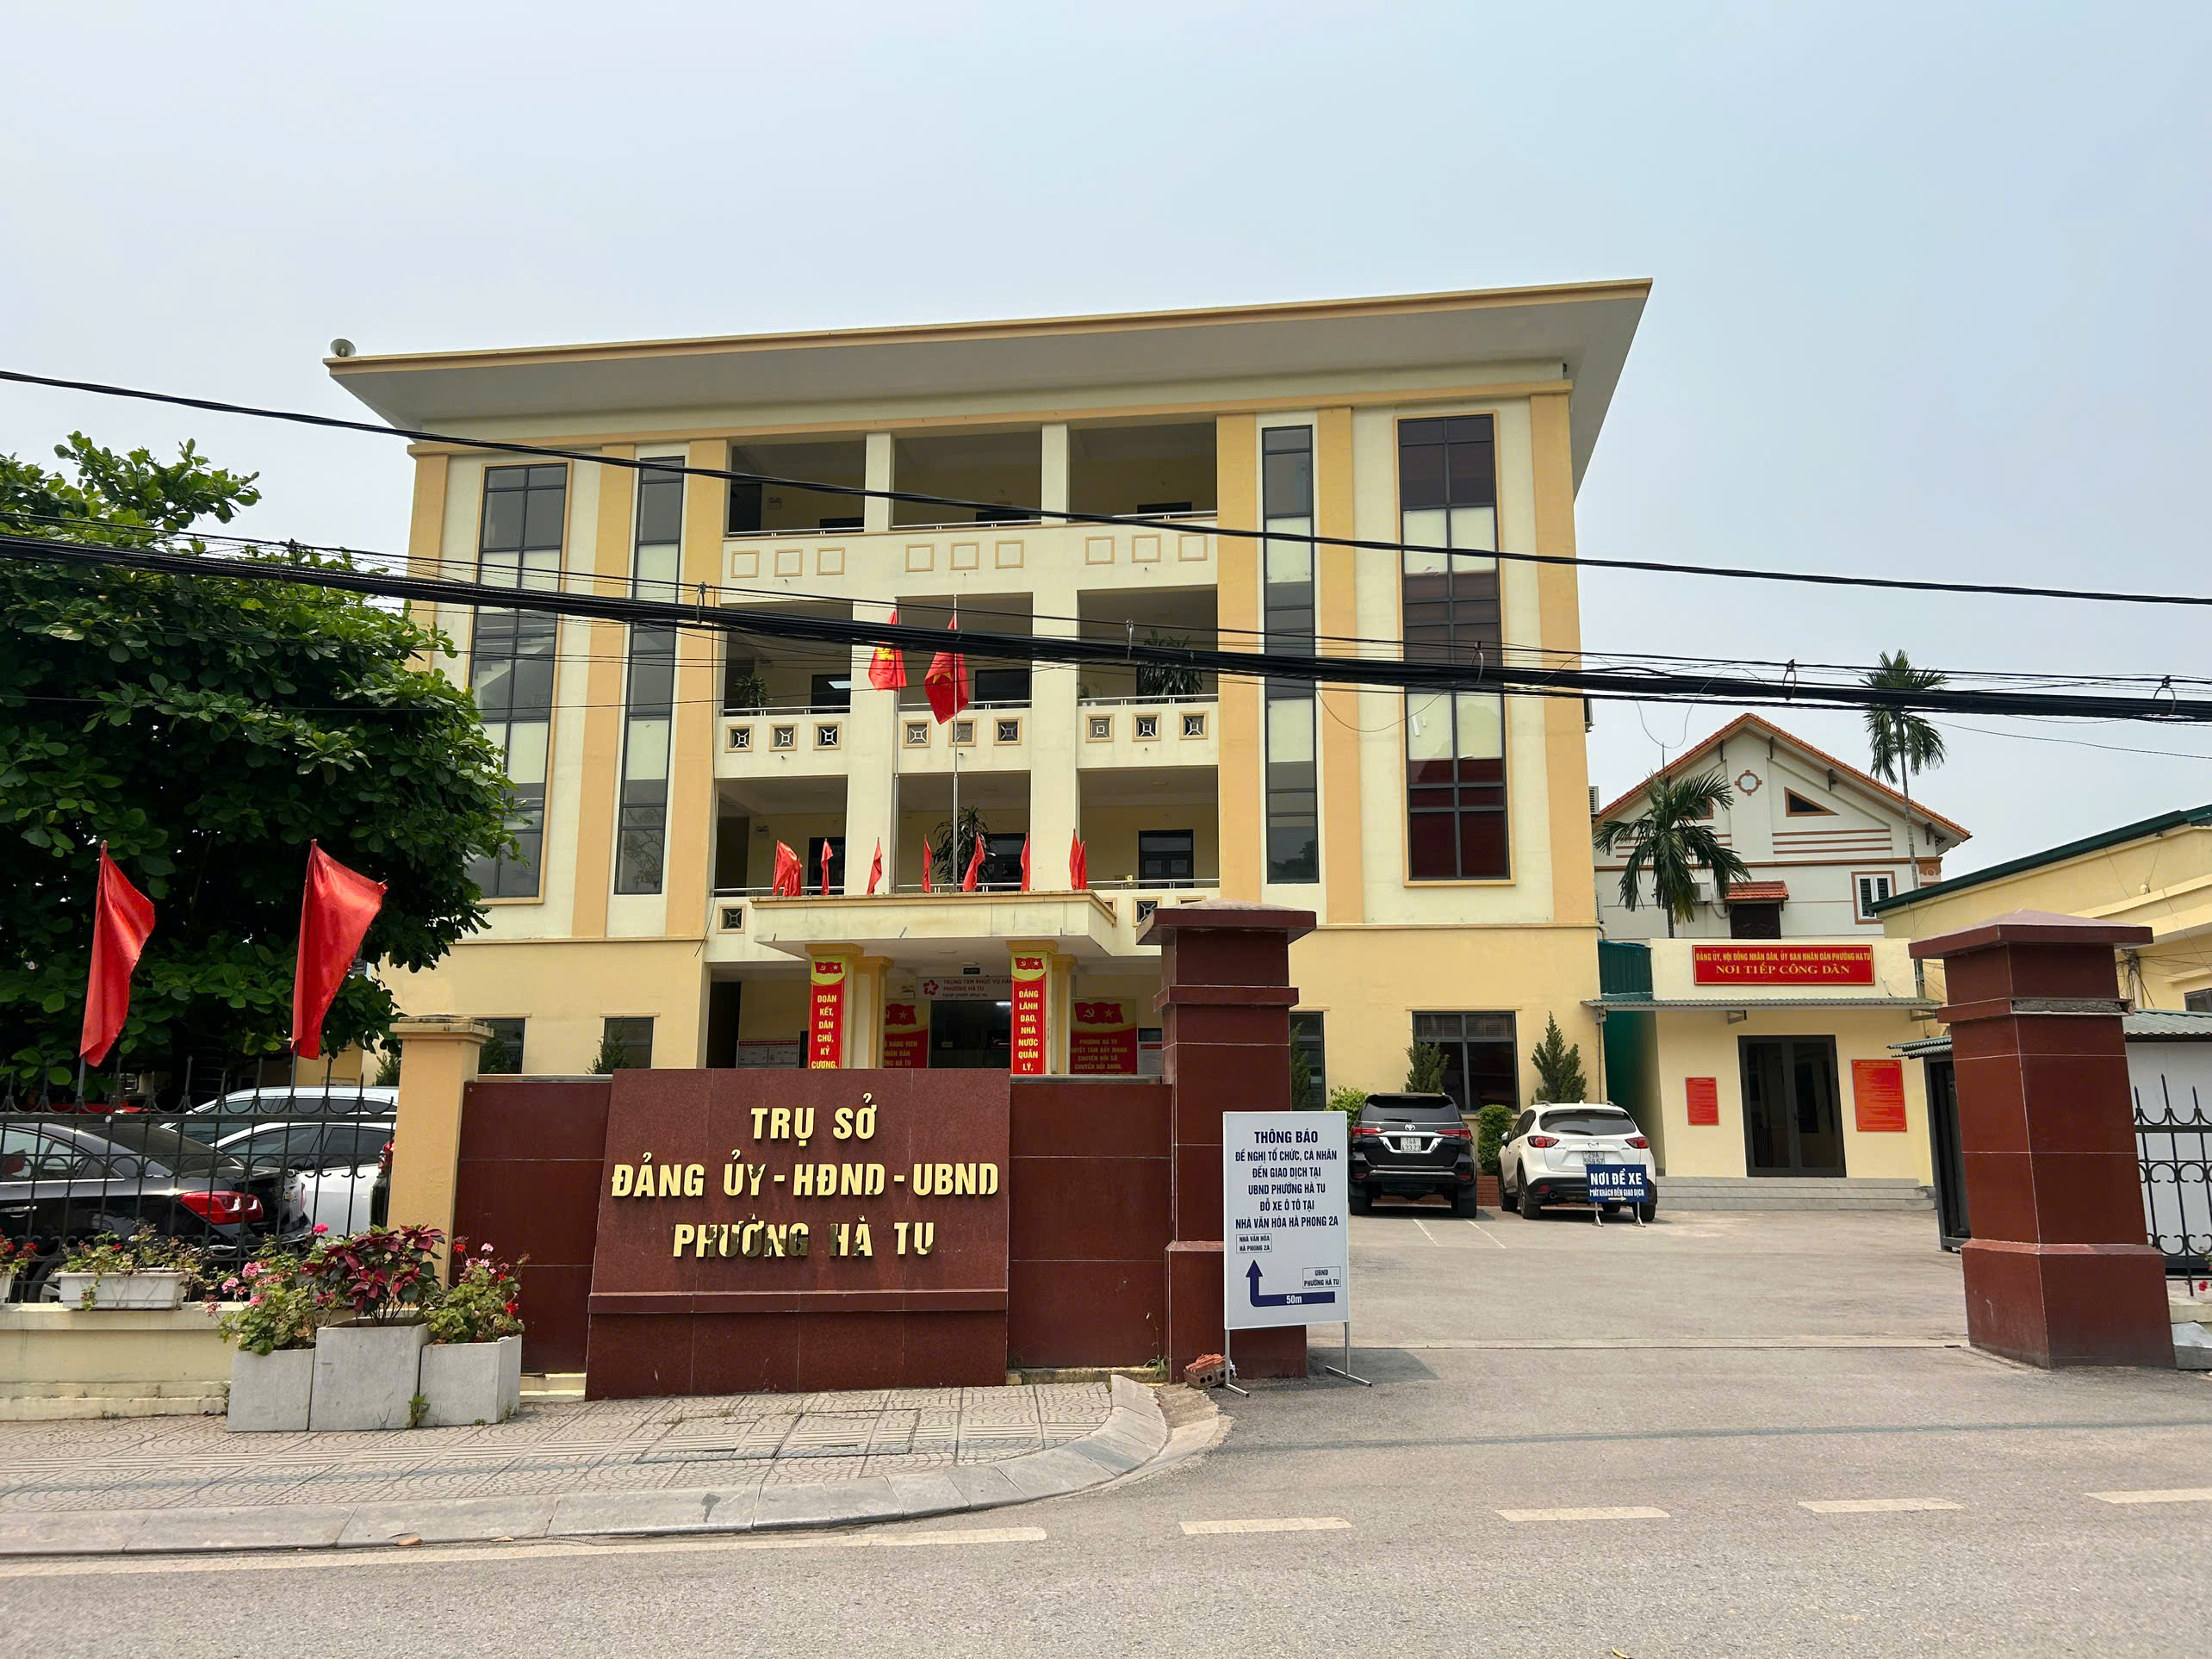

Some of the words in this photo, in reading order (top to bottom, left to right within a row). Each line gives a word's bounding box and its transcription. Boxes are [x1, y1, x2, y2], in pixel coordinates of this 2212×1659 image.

[1749, 951, 1765, 961] NHÂN
[1789, 952, 1801, 961] BAN
[1802, 951, 1818, 961] NHÂN
[1819, 951, 1831, 961] DÂN
[1715, 965, 1740, 974] NƠI
[1743, 961, 1776, 974] TIẾP
[1779, 963, 1817, 974] CÔNG
[1822, 963, 1850, 974] DÂN
[817, 993, 837, 1003] ĐOÀN
[1018, 989, 1039, 998] ĐẢNG
[1019, 1001, 1038, 1010] LÃNH
[818, 1019, 834, 1029] DÂN
[1021, 1025, 1036, 1035] NHÀ
[1018, 1037, 1039, 1047] NƯỚC
[1018, 1048, 1039, 1059] QUẢN
[750, 1107, 815, 1146] TRỤ
[832, 1092, 878, 1140] SỞ
[1254, 1128, 1292, 1144] THÔNG
[1296, 1128, 1319, 1144] BÁO
[1247, 1151, 1266, 1163] NGHỊ
[1268, 1146, 1277, 1161] TỔ
[1279, 1148, 1302, 1162] CHỨC,
[1316, 1148, 1338, 1160] NHÂN
[611, 1152, 705, 1197] ĐẢNG
[723, 1148, 767, 1196] ỦY
[792, 1163, 886, 1196] HĐND
[912, 1163, 999, 1196] UBND
[1252, 1165, 1268, 1178] ĐẾN
[1270, 1167, 1288, 1177] GIAO
[1289, 1167, 1308, 1179] DỊCH
[1309, 1166, 1321, 1179] TẠI
[1590, 1171, 1610, 1185] NƠI
[1611, 1167, 1626, 1185] ĐỂ
[1628, 1172, 1643, 1185] XE
[1248, 1184, 1269, 1196] UBND
[1271, 1181, 1302, 1195] PHƯỜNG
[1304, 1181, 1314, 1194] HÀ
[1316, 1183, 1326, 1193] TU
[1272, 1201, 1283, 1211] XE
[1284, 1198, 1289, 1211] Ô
[1291, 1198, 1301, 1211] TÔ
[1302, 1200, 1314, 1214] TẠI
[1235, 1216, 1252, 1229] NHÀ
[1253, 1216, 1270, 1228] VĂN
[1271, 1215, 1287, 1228] HÓA
[1289, 1215, 1300, 1227] HÀ
[1301, 1216, 1327, 1227] PHONG
[1328, 1215, 1339, 1227] 2A
[672, 1213, 810, 1258] PHƯỜNG
[829, 1215, 873, 1258] HÀ
[893, 1221, 935, 1256] TU
[1303, 1278, 1324, 1287] PHƯỜNG
[1325, 1277, 1333, 1286] HÀ
[1286, 1295, 1302, 1304] 50m
